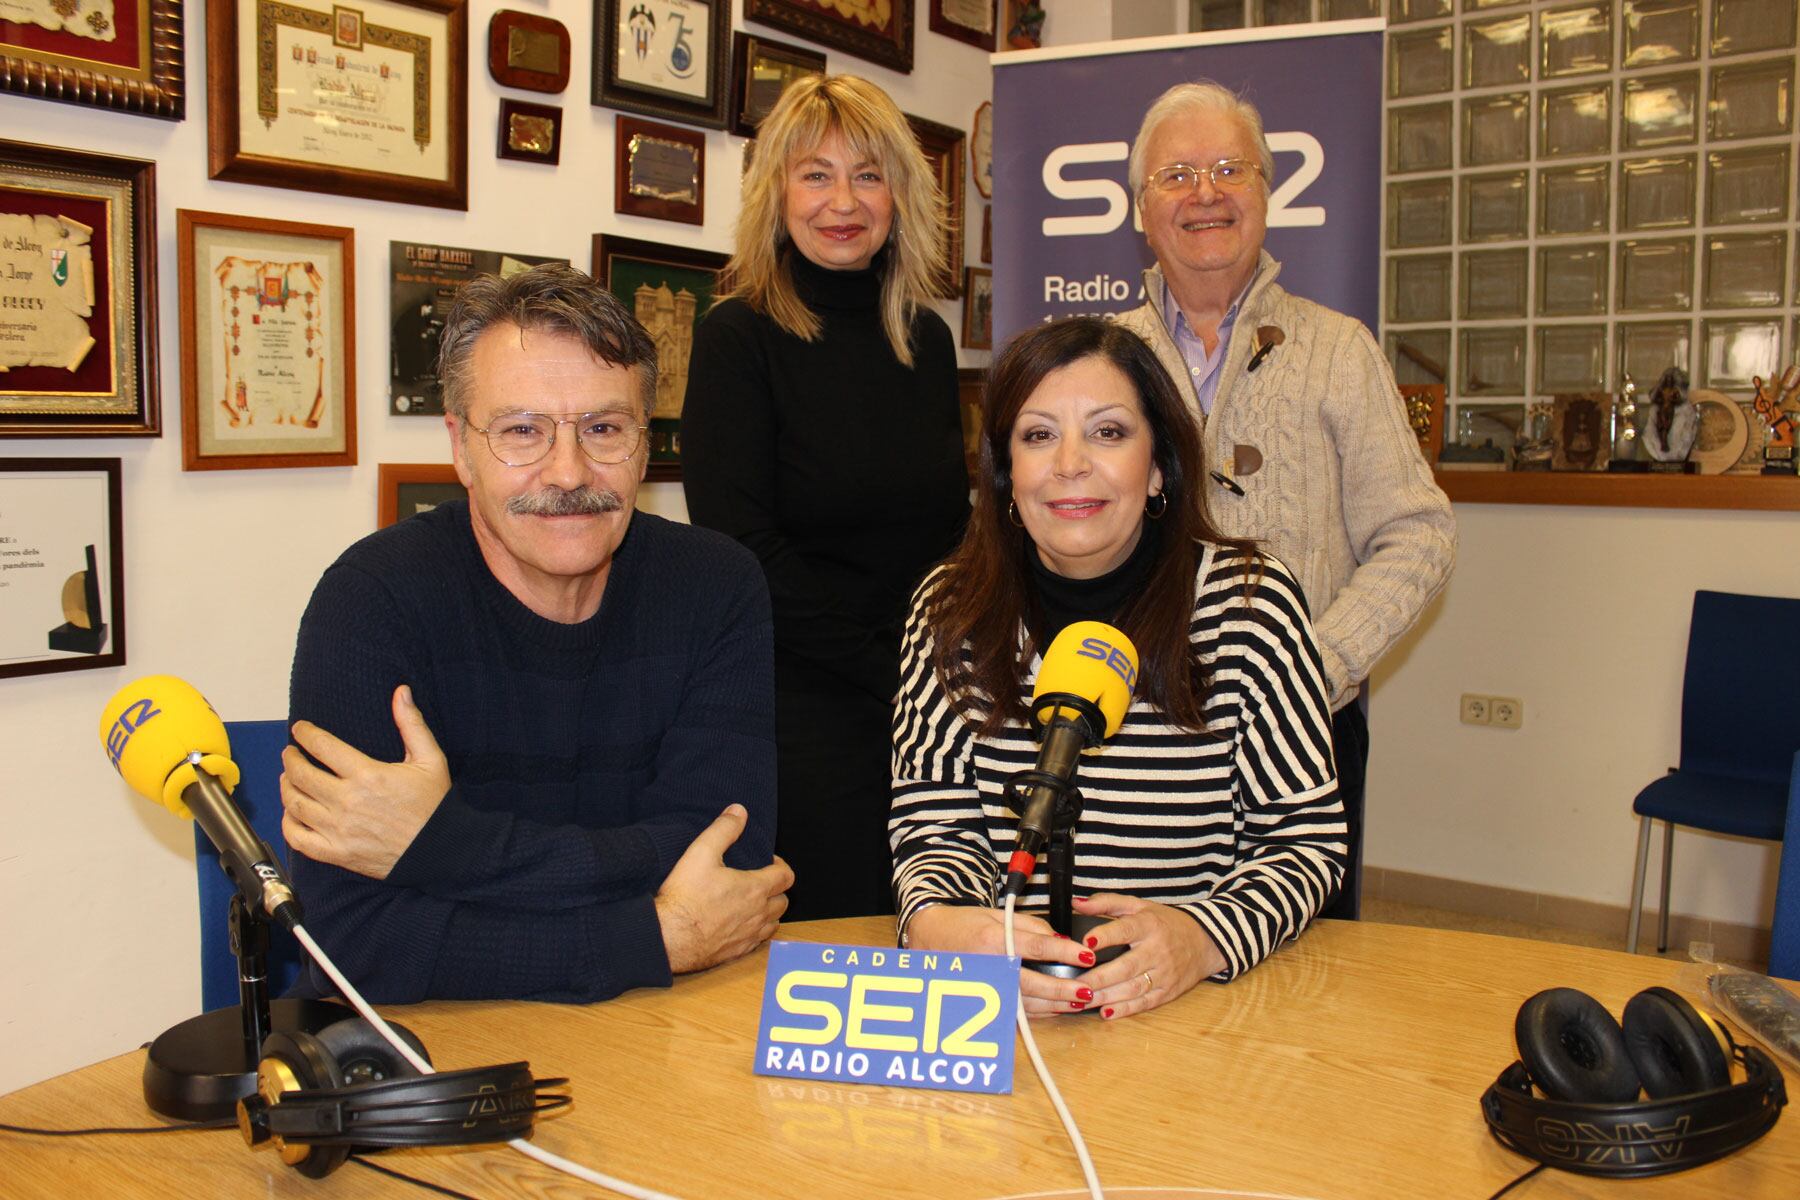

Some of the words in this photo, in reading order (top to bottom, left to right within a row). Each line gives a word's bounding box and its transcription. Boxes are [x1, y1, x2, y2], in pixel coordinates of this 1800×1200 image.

[1044, 275, 1130, 302] Radio
[821, 949, 963, 972] CADENA
[769, 970, 1001, 1058] SER
[766, 1046, 869, 1077] RADIO
[886, 1055, 998, 1086] ALCOY
